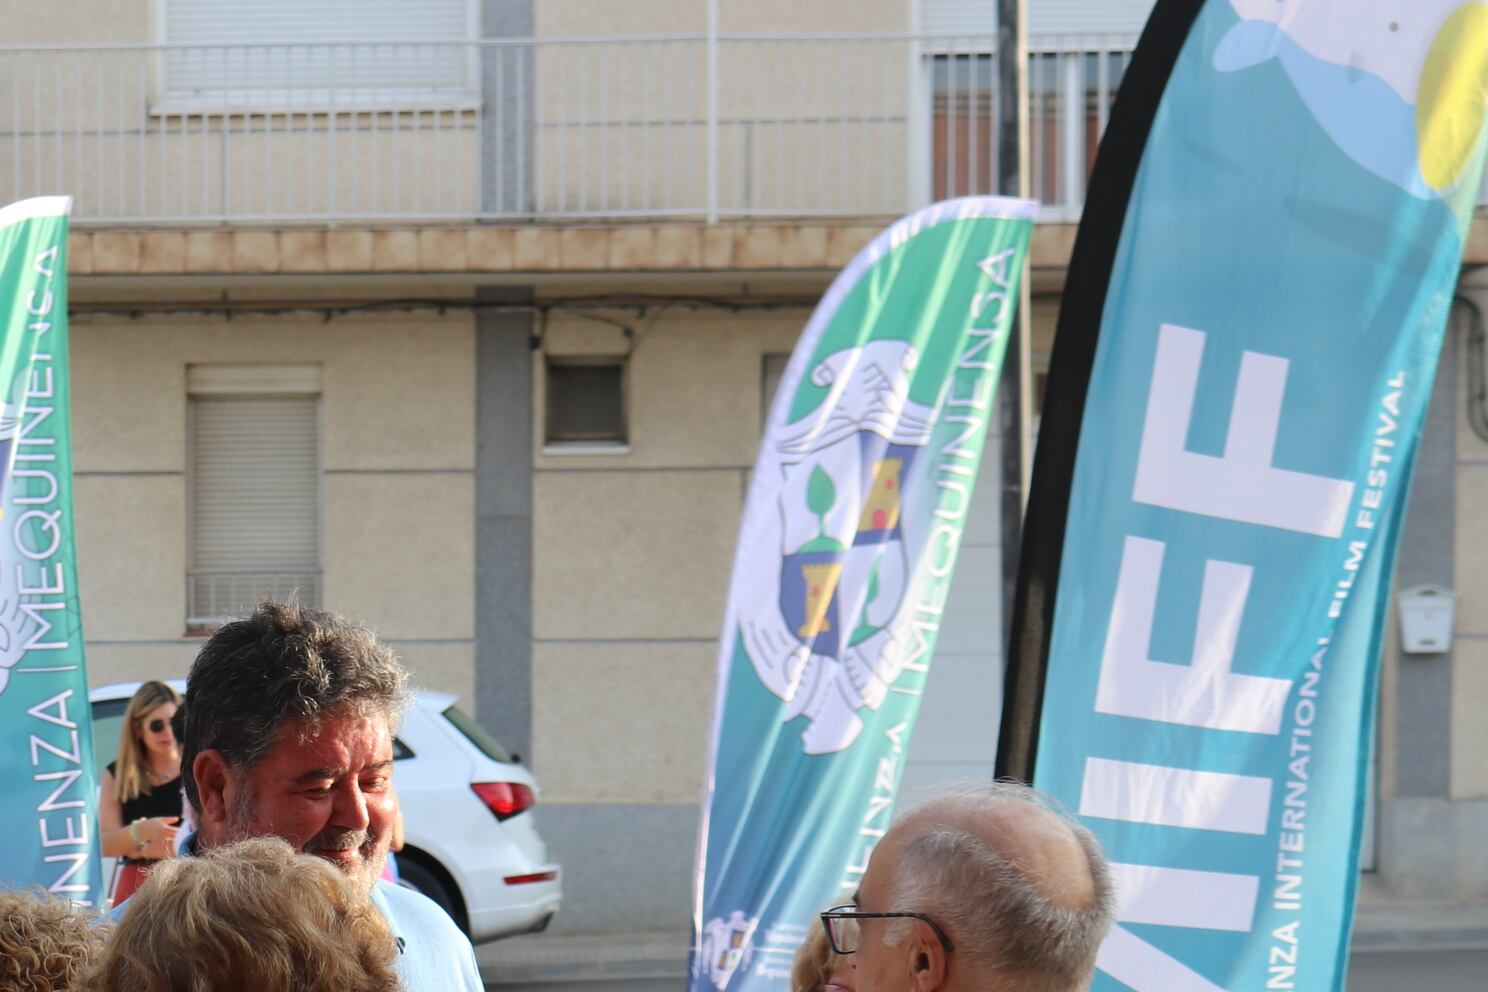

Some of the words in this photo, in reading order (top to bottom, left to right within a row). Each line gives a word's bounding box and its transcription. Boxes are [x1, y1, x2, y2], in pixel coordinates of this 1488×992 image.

[1273, 629, 1332, 911] INTERNATIONAL
[1327, 540, 1367, 618] FILM
[1355, 370, 1405, 529] FESTIVAL
